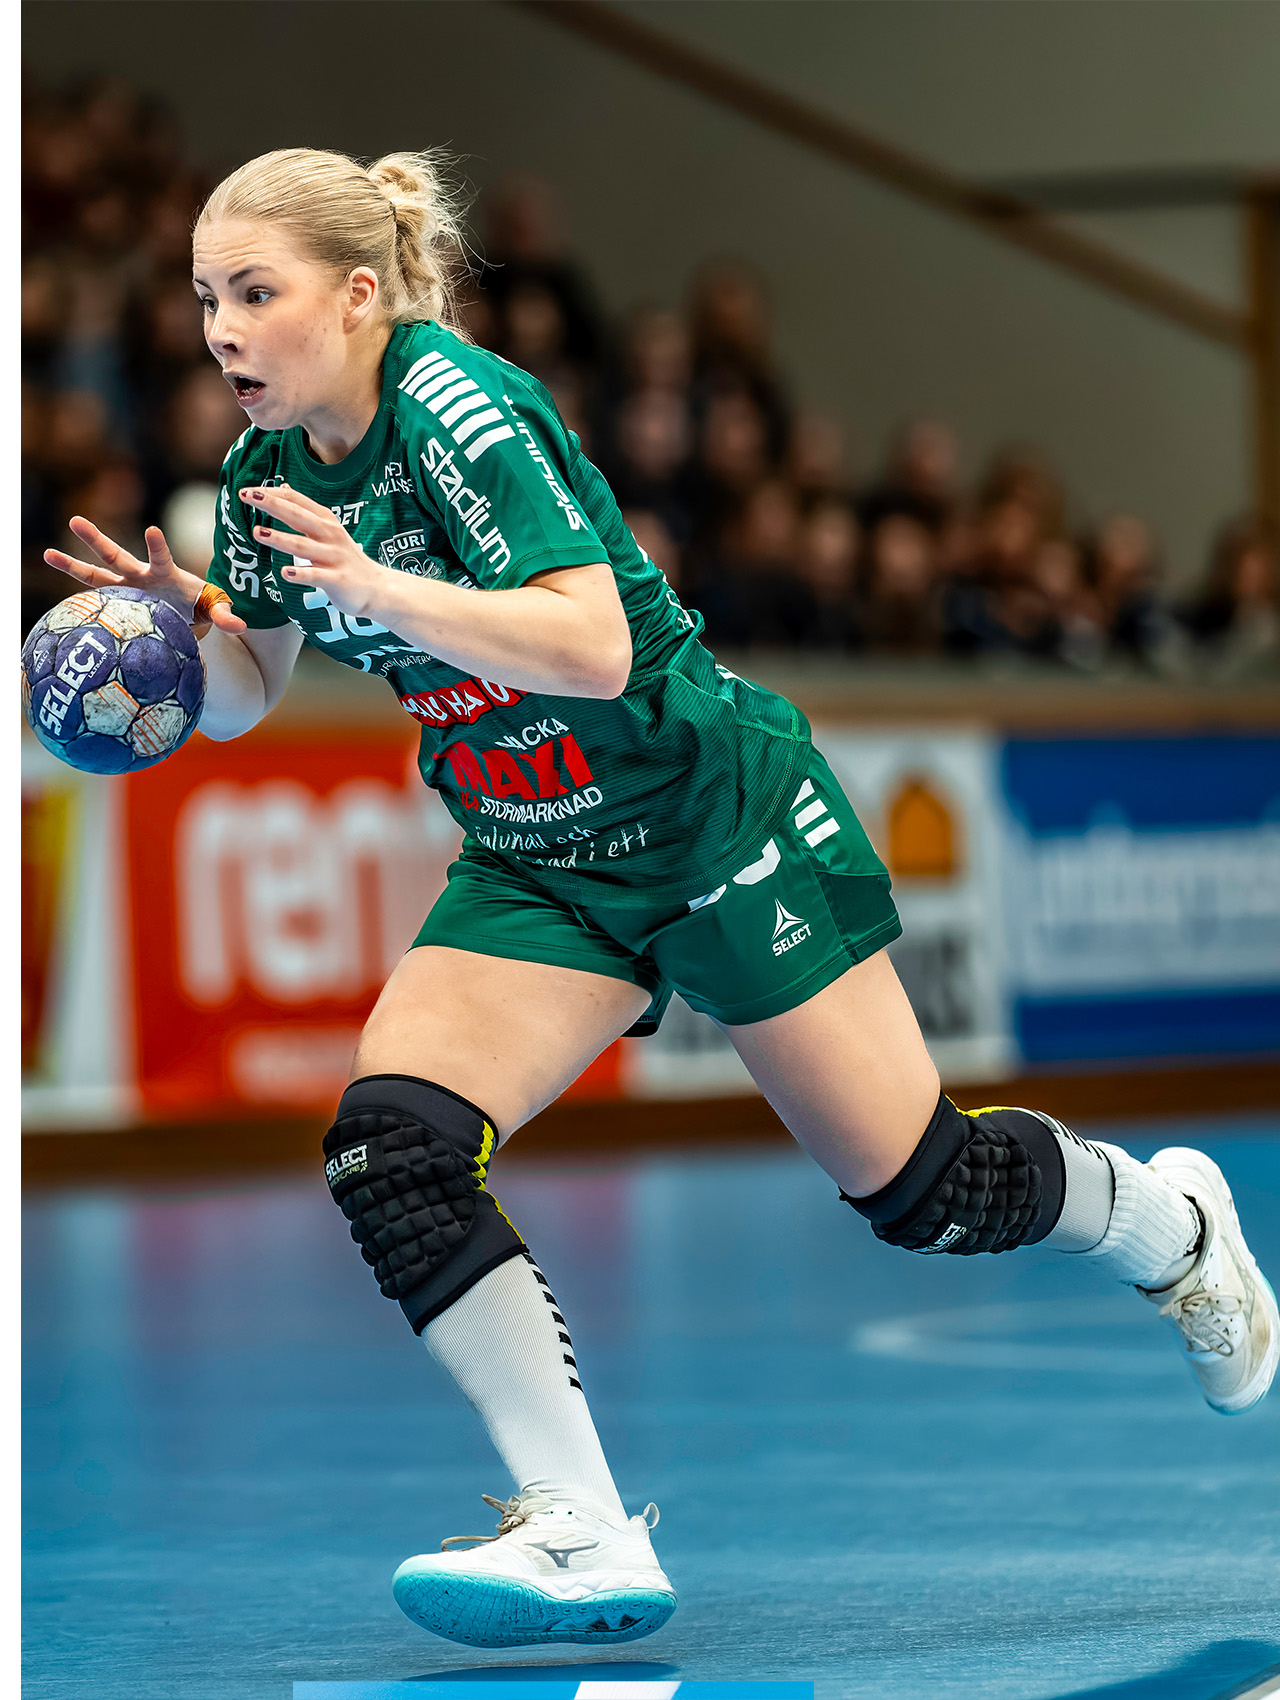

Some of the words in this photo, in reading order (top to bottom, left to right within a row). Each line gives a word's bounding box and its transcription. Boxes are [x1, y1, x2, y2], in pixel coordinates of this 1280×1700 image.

[331, 500, 365, 526] BET
[420, 437, 512, 575] stadium
[39, 630, 107, 737] SELECT
[434, 733, 595, 800] MAXI
[480, 786, 604, 824] STORMARKNAD
[772, 923, 812, 957] SELECT
[326, 1144, 368, 1182] SELECT
